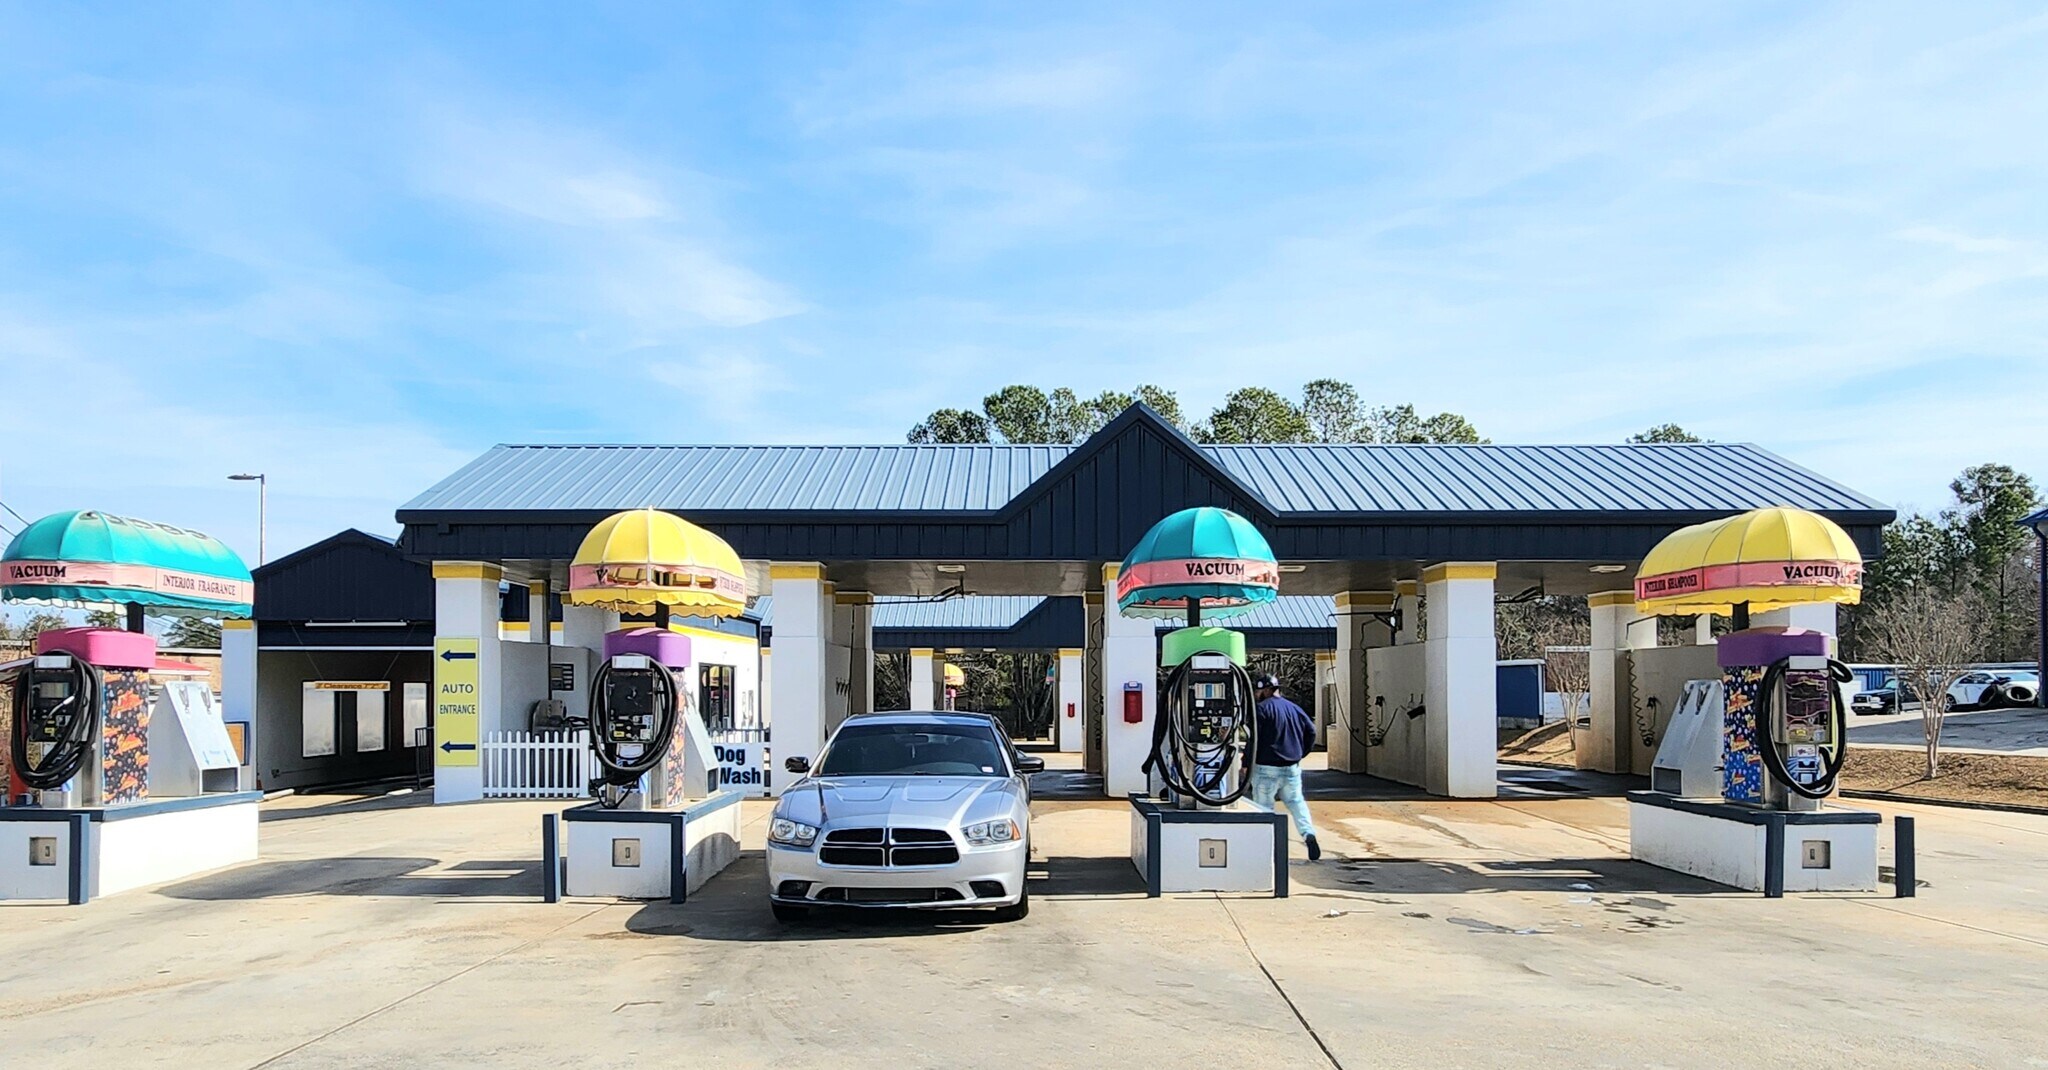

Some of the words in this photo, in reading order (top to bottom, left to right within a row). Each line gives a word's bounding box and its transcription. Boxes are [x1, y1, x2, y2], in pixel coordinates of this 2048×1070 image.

[10, 565, 67, 578] VACUUM
[1185, 563, 1245, 576] VACUUM
[1783, 565, 1844, 579] VACUUM
[163, 575, 195, 590] INTERIOR
[198, 580, 236, 596] FRAGRANCE
[441, 683, 474, 694] AUTO
[439, 704, 476, 715] ENTRANCE
[714, 746, 745, 766] Dog
[720, 767, 761, 784] Wash
